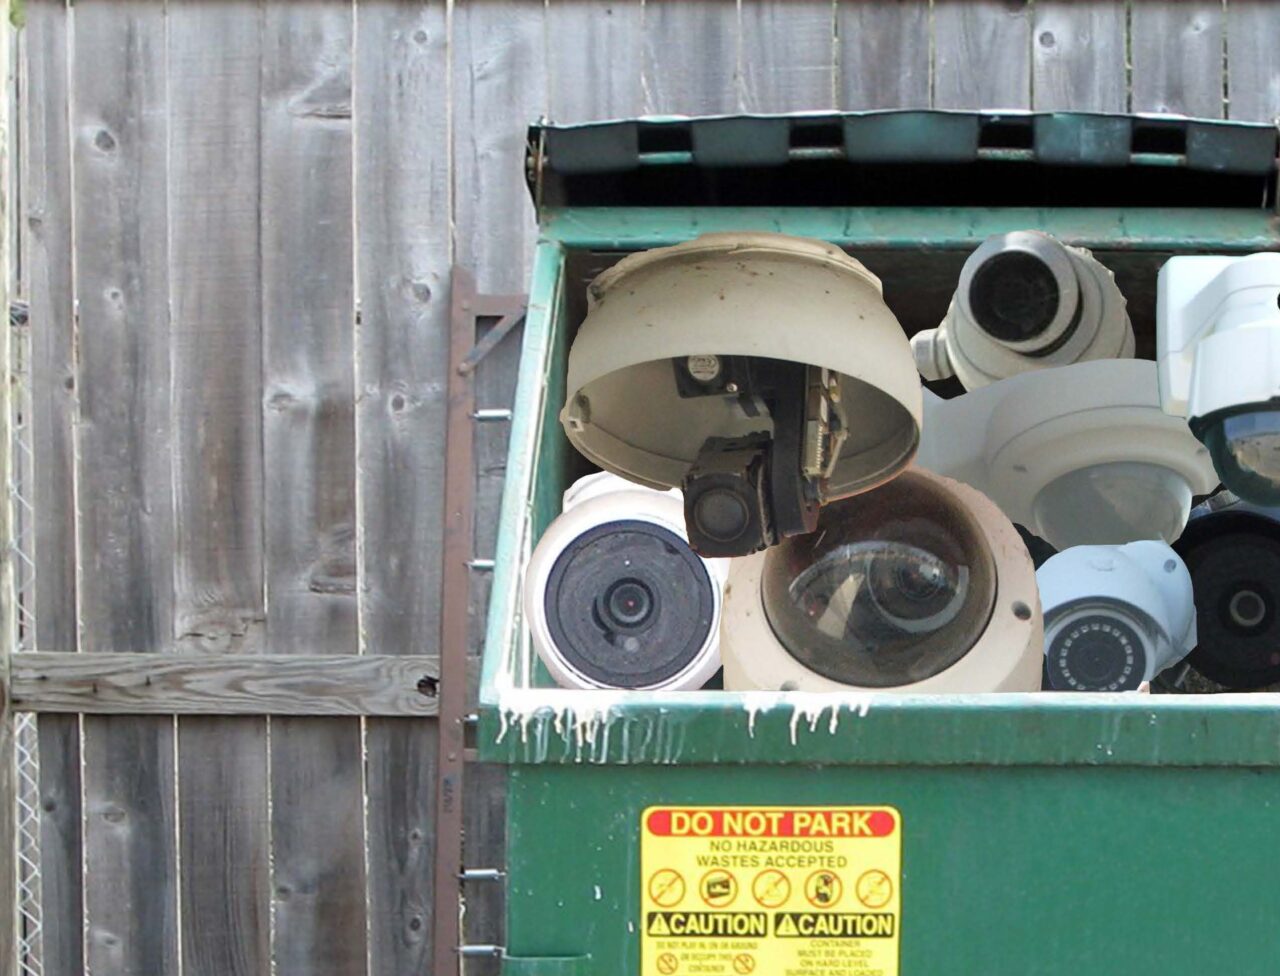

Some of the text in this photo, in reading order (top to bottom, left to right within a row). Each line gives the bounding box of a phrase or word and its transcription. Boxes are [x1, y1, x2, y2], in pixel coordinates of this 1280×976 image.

[671, 812, 873, 835] DO NOT PARK
[710, 840, 834, 853] NO HAZARDOUS
[697, 856, 847, 868] WASTES ACCEPTED
[670, 913, 766, 935] CAUTION
[798, 913, 893, 935] CAUTION
[810, 940, 861, 948] CONTAINER
[800, 959, 869, 967] ON HARD LEVEL
[785, 969, 884, 976] SURFACE AND LOADED
